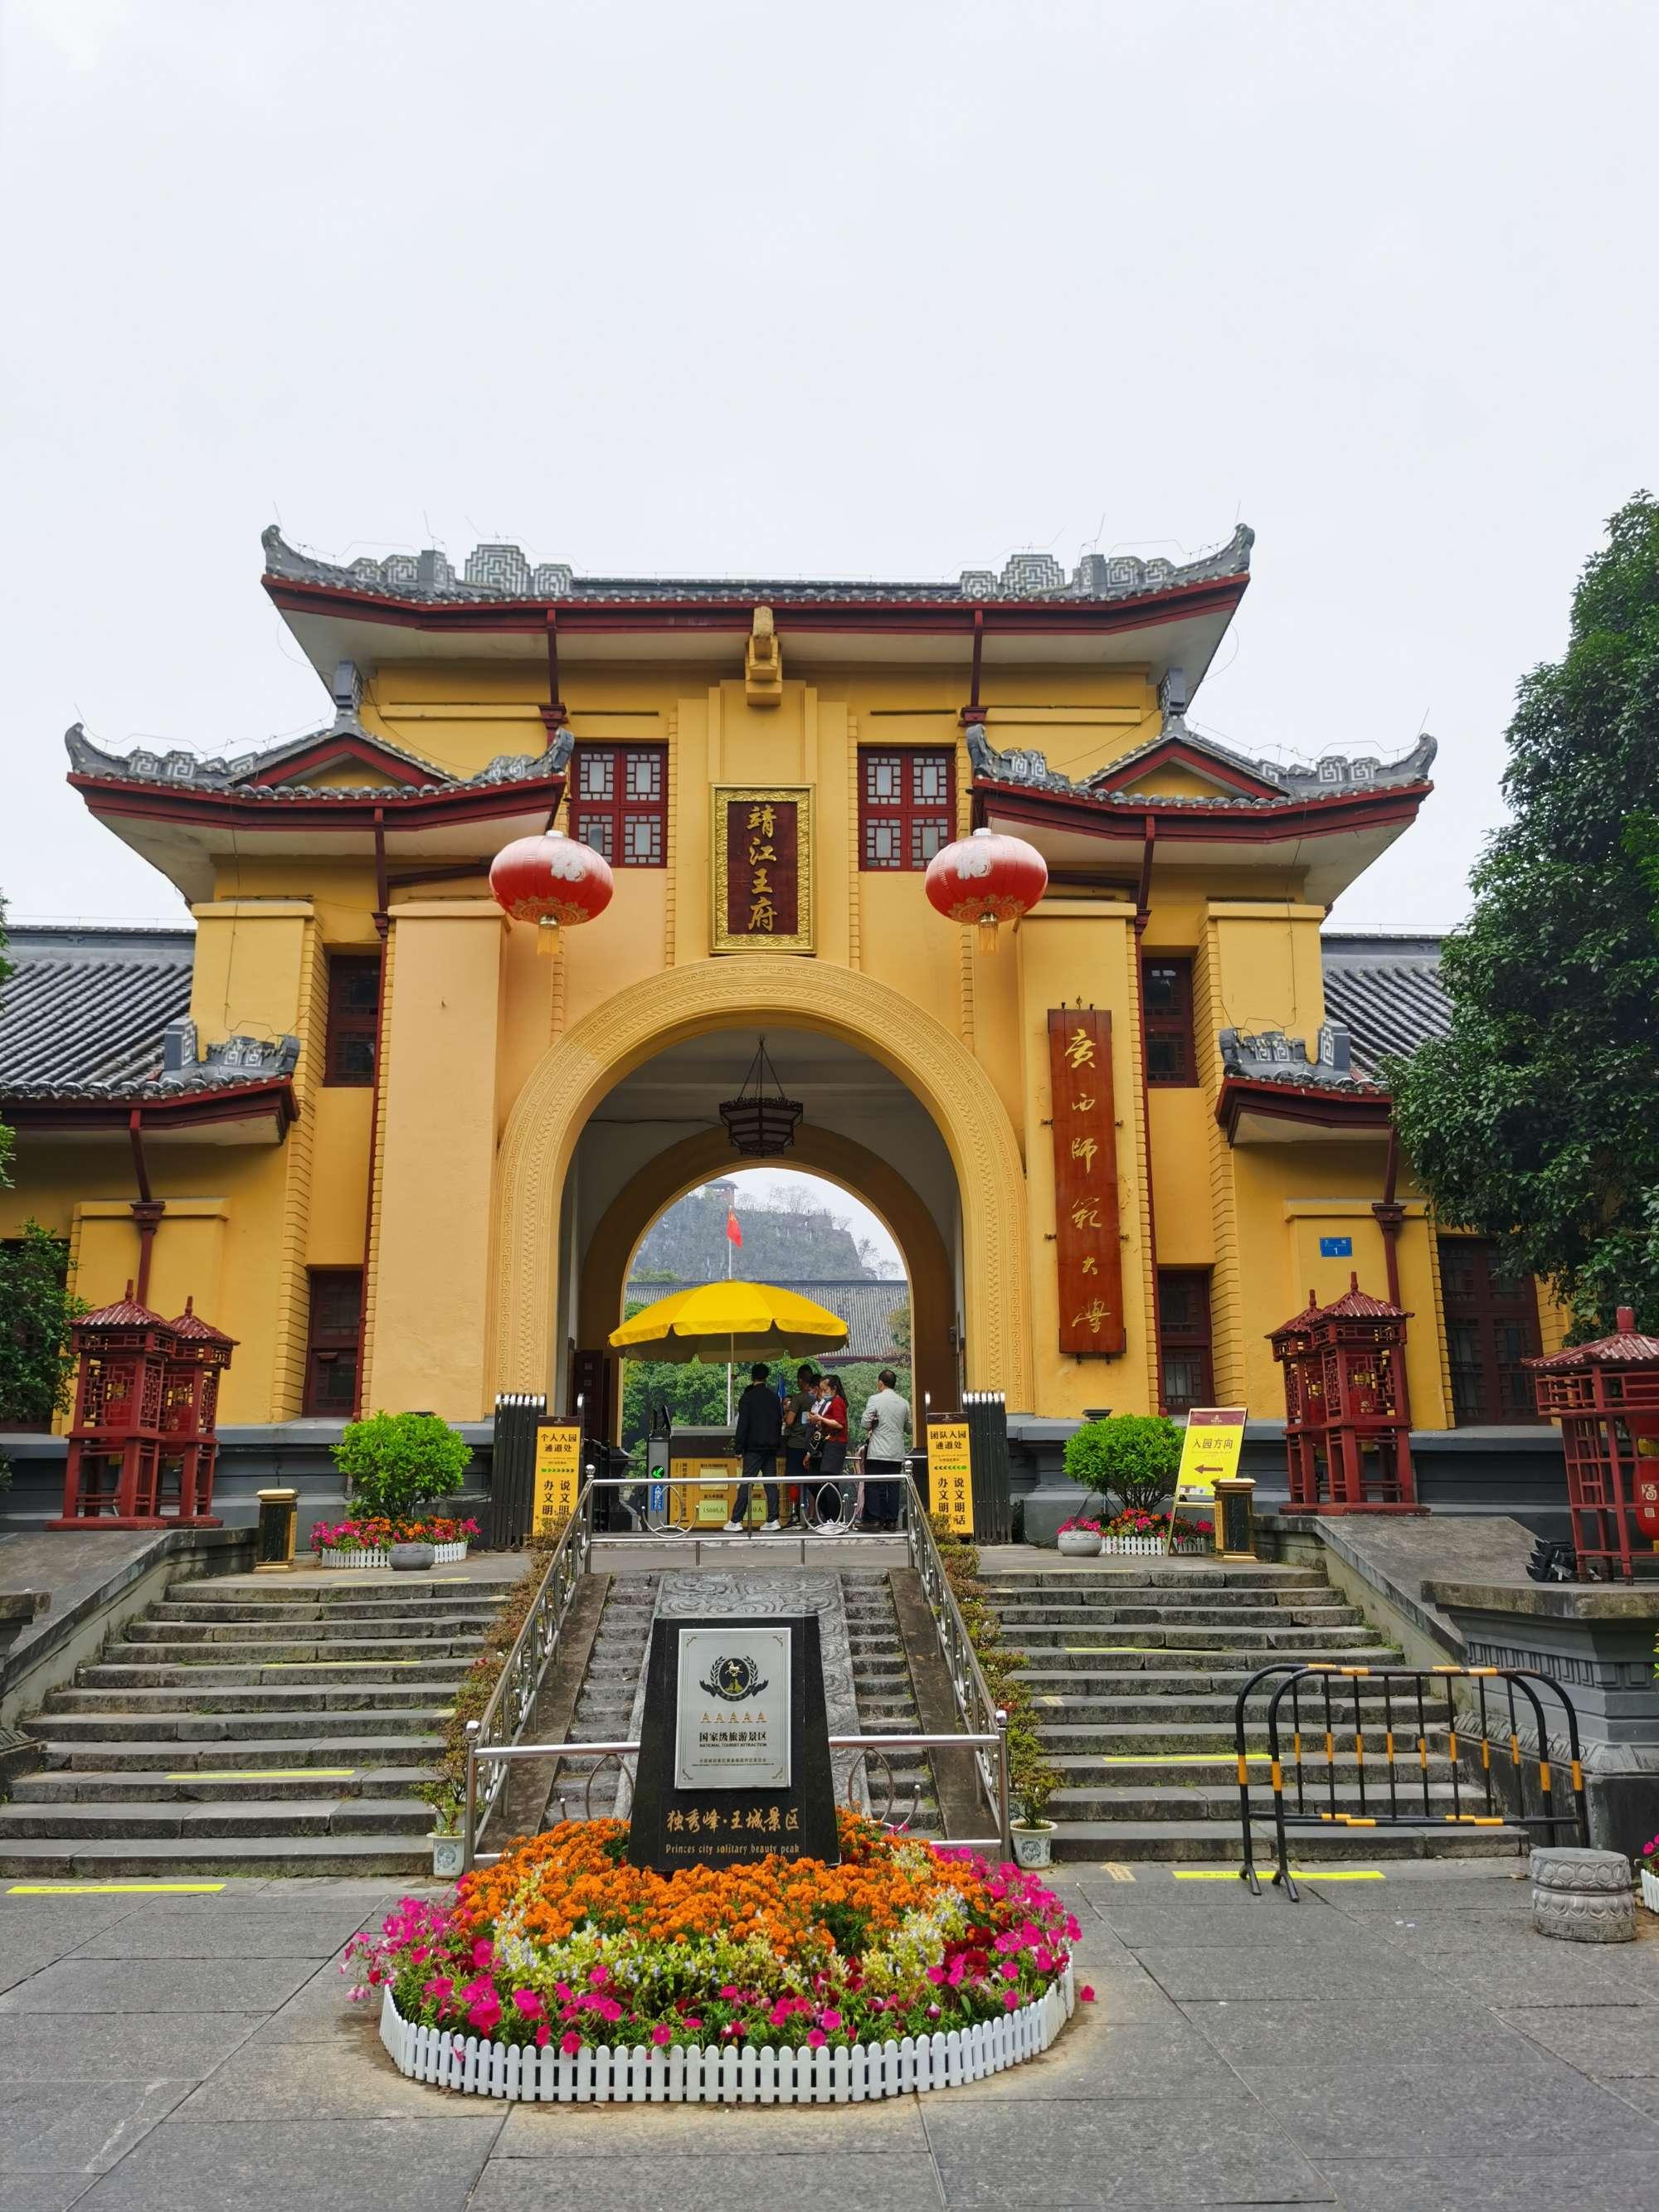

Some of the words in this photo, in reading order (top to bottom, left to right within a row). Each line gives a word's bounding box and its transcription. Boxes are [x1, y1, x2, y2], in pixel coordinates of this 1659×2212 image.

[747, 805, 778, 931] 靖江王府
[541, 1433, 577, 1441] 个人入园
[930, 1431, 966, 1439] 团队入园
[544, 1444, 572, 1452] 通道处
[936, 1441, 963, 1449] 通道处
[1193, 1438, 1233, 1449] 入园方向
[937, 1477, 949, 1524] 办文明
[954, 1477, 966, 1525] 说文明话
[699, 1732, 766, 1742] 国家级旅游景区
[665, 1844, 695, 1854] Princes
[698, 1844, 713, 1855] city
[716, 1844, 747, 1855] solitary
[751, 1843, 777, 1855] beauty
[781, 1843, 800, 1855] peak
